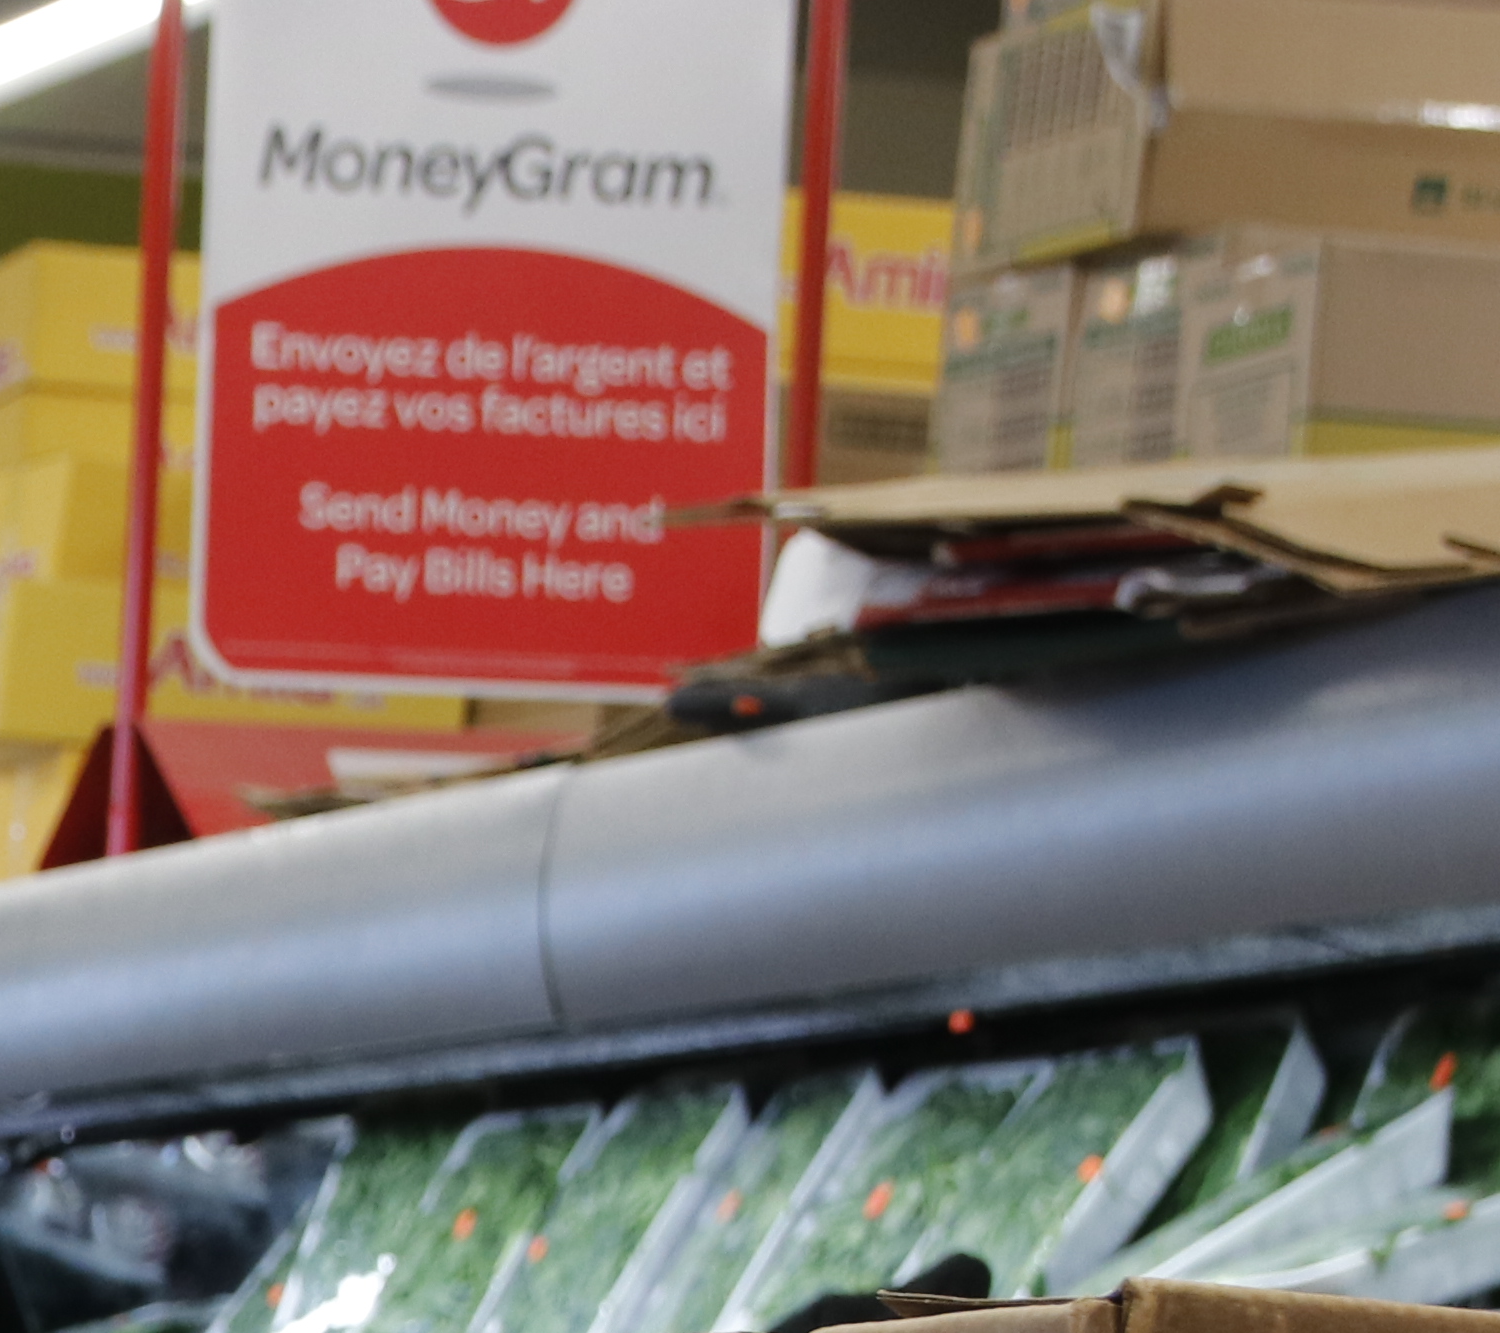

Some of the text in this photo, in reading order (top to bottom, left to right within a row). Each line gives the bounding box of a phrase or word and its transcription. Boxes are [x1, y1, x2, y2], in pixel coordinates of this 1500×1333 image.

[258, 122, 717, 218] MoneyGram
[249, 319, 438, 384] Envoyez
[444, 331, 505, 381] de
[681, 343, 732, 390] et
[251, 383, 728, 442] payez vos factures ici
[298, 480, 667, 548] Send Money and
[335, 542, 635, 603] Pay Bills Here
